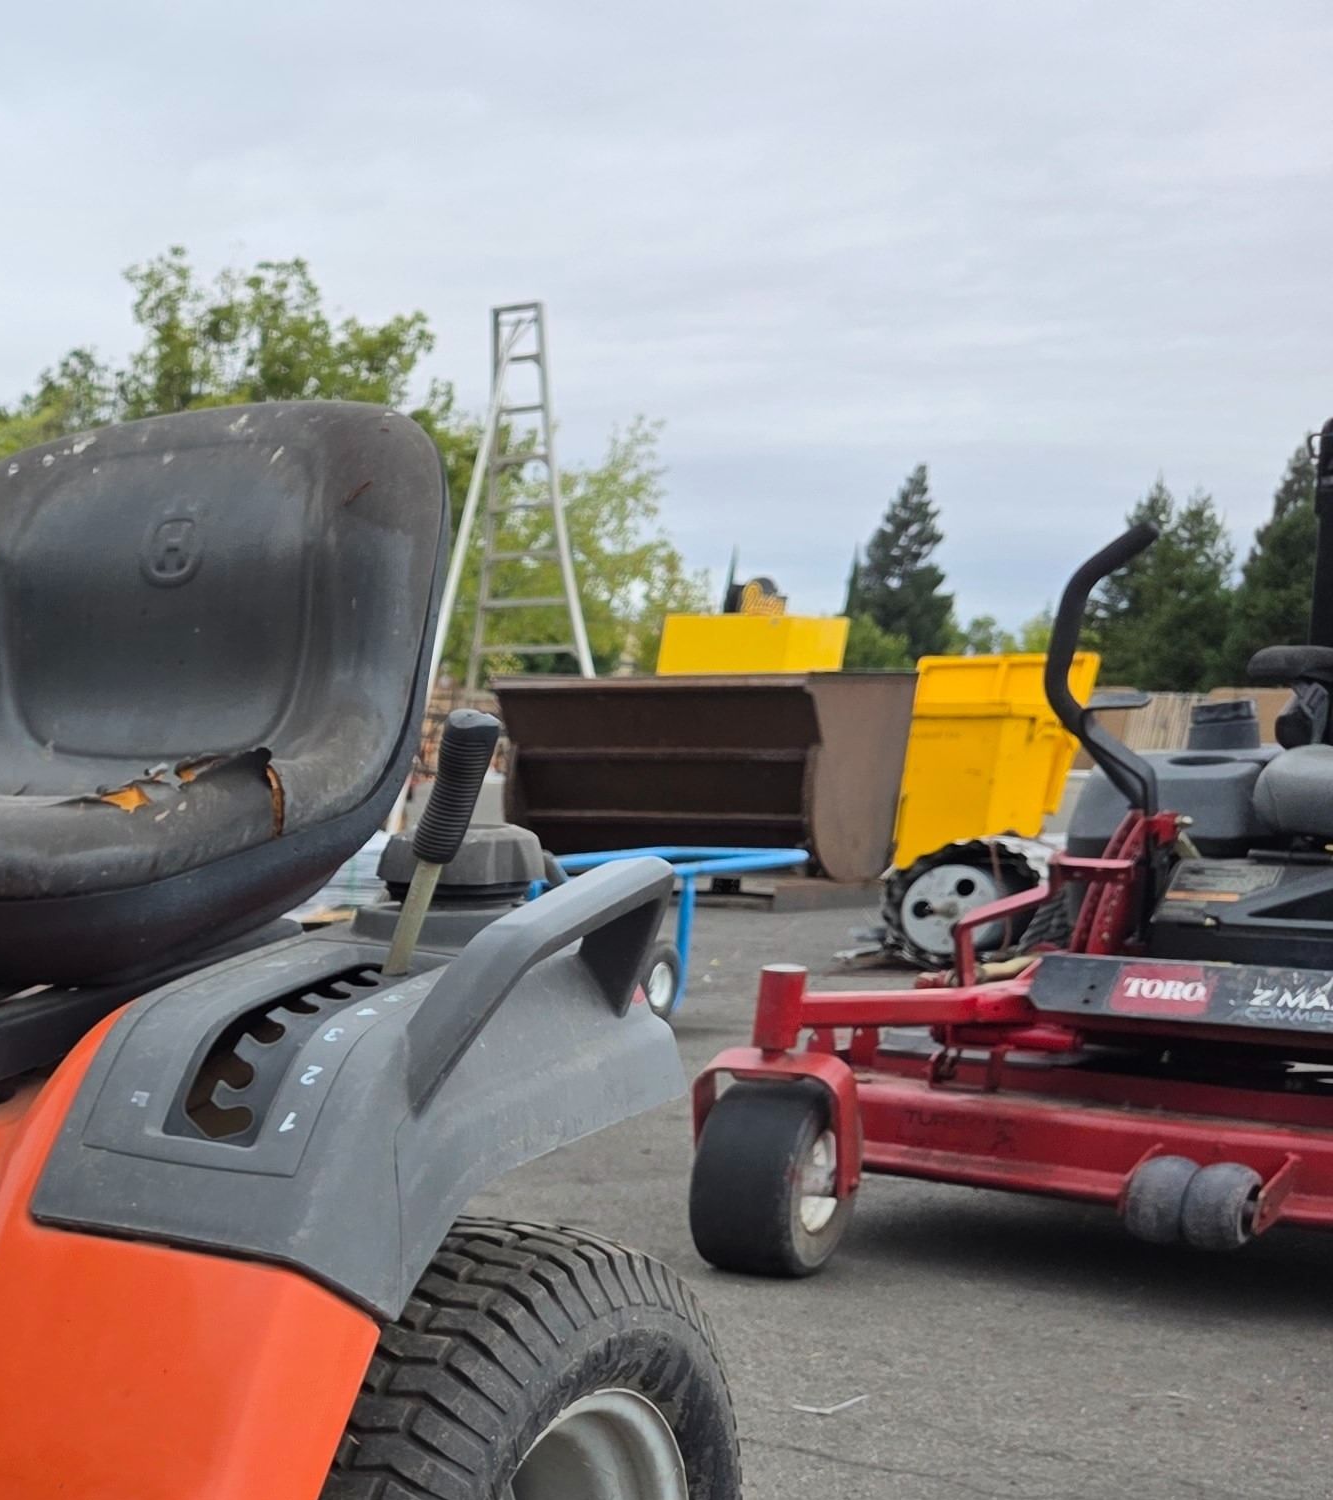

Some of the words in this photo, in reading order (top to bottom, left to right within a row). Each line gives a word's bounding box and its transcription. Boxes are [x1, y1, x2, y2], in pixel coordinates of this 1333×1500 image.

[1124, 977, 1207, 1002] TORO
[1276, 988, 1333, 1012] MA
[323, 1026, 344, 1042] 3
[300, 1064, 323, 1086] 2
[278, 1111, 297, 1133] 1
